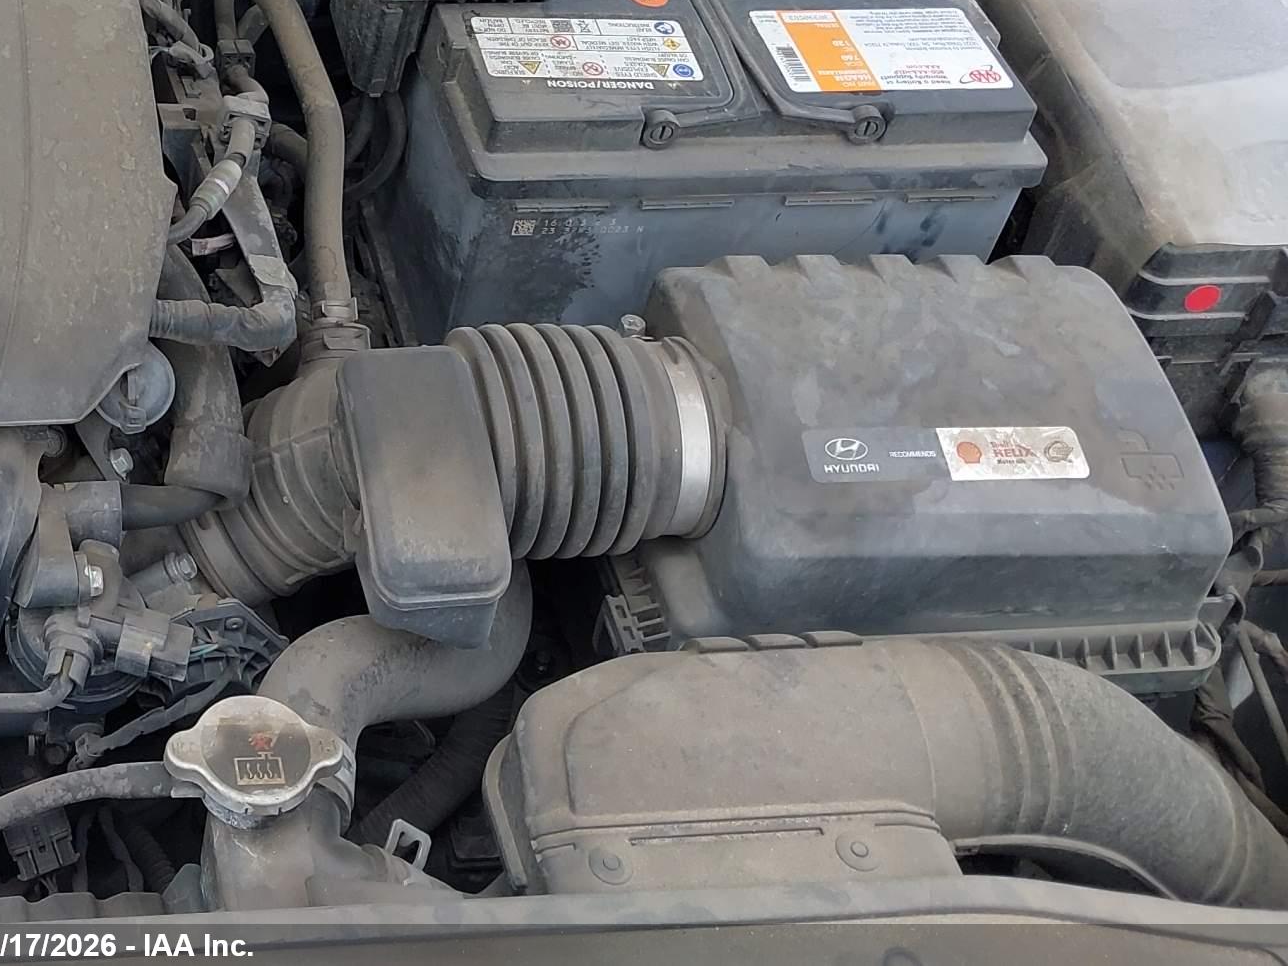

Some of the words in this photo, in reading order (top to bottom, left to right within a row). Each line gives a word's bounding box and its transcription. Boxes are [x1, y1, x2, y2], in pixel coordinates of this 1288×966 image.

[546, 80, 655, 90] DANGER/POISON
[823, 463, 880, 474] HYUNDAI
[889, 450, 936, 458] RECOMMENDS
